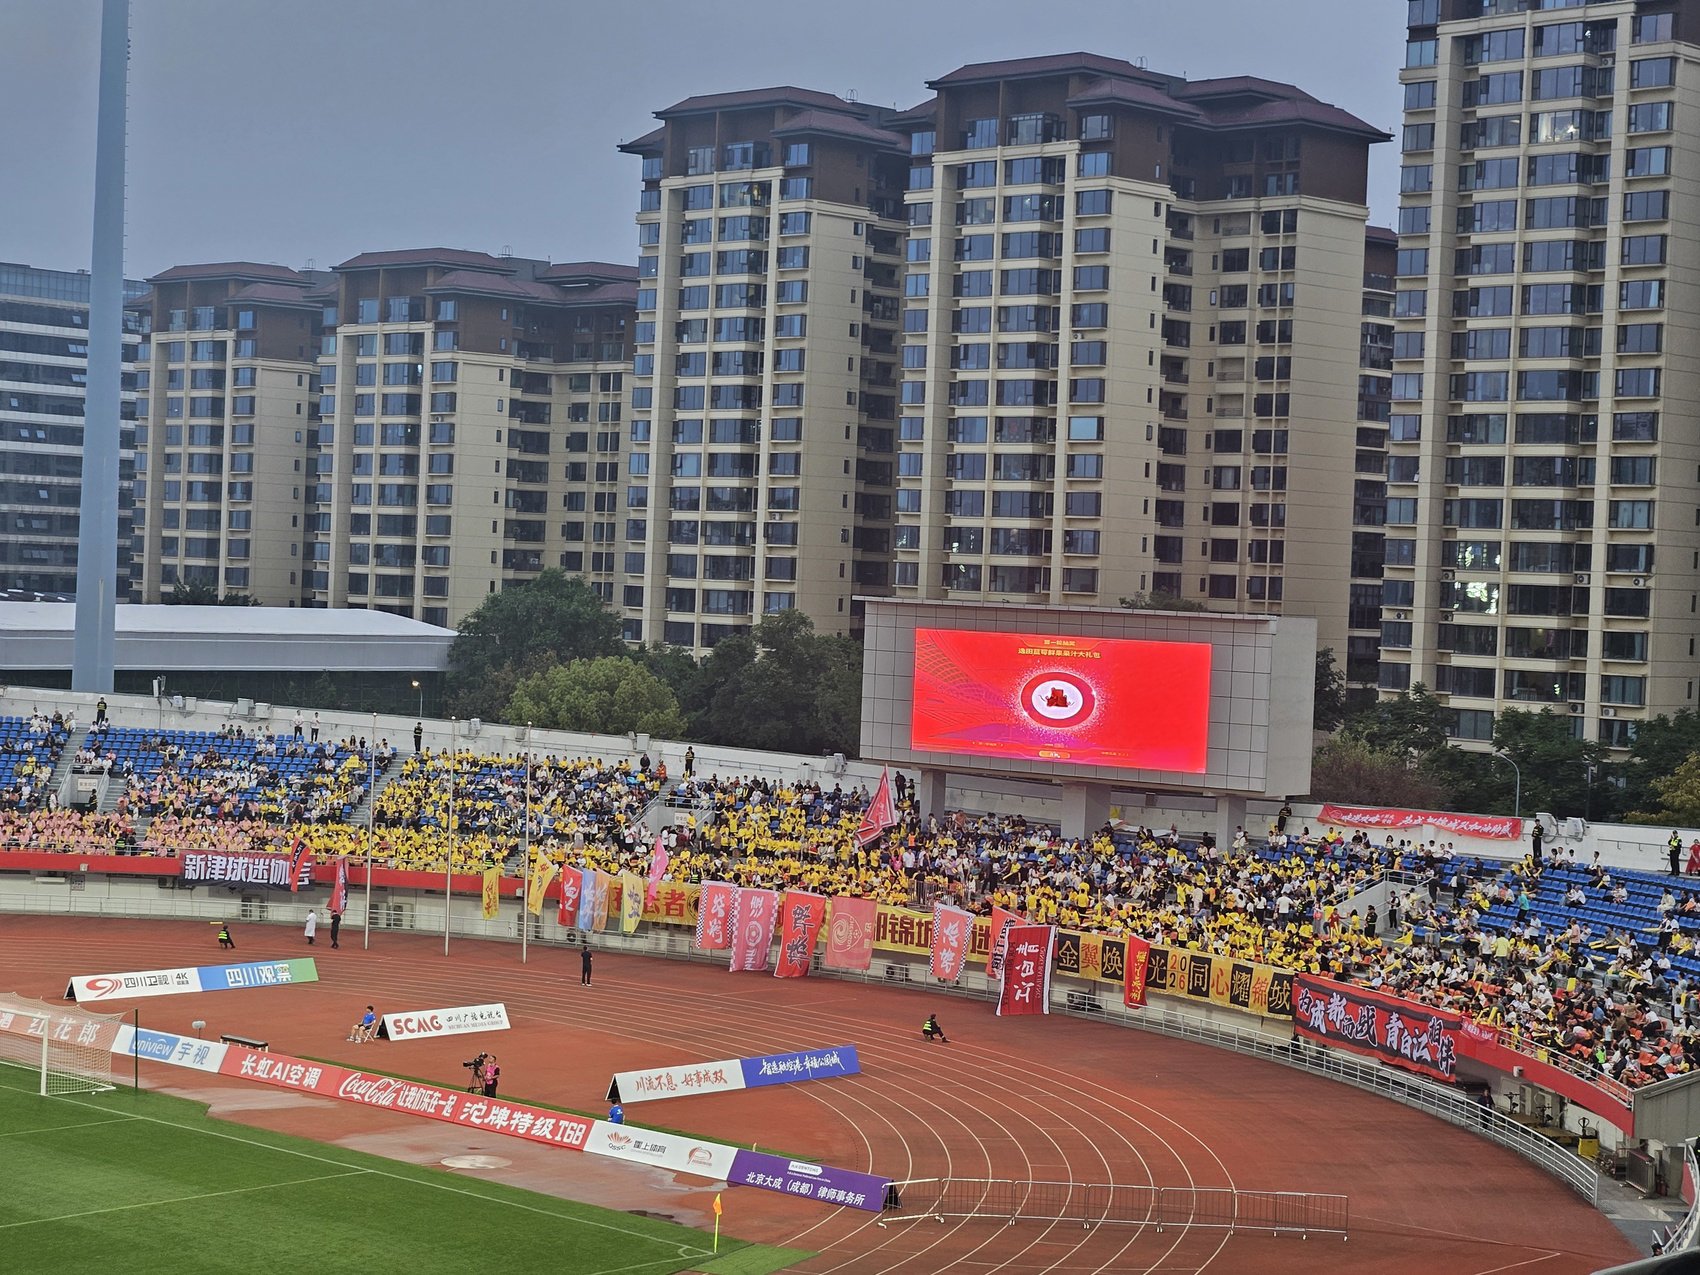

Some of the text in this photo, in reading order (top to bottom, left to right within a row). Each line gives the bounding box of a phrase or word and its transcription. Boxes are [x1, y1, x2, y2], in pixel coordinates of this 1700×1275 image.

[123, 972, 188, 988] 四川卫视 4K
[226, 963, 292, 987] 四川观察
[1058, 940, 1167, 984] 金翼焕光
[1188, 960, 1291, 1011] 同心耀锦城
[393, 1015, 443, 1035] SCMG
[132, 1038, 210, 1065] uniview 宇视
[240, 1053, 323, 1089] 长虹AI空调
[635, 1068, 728, 1095] 川流不息 好事成双
[397, 1084, 457, 1117] 让我们乐在一起
